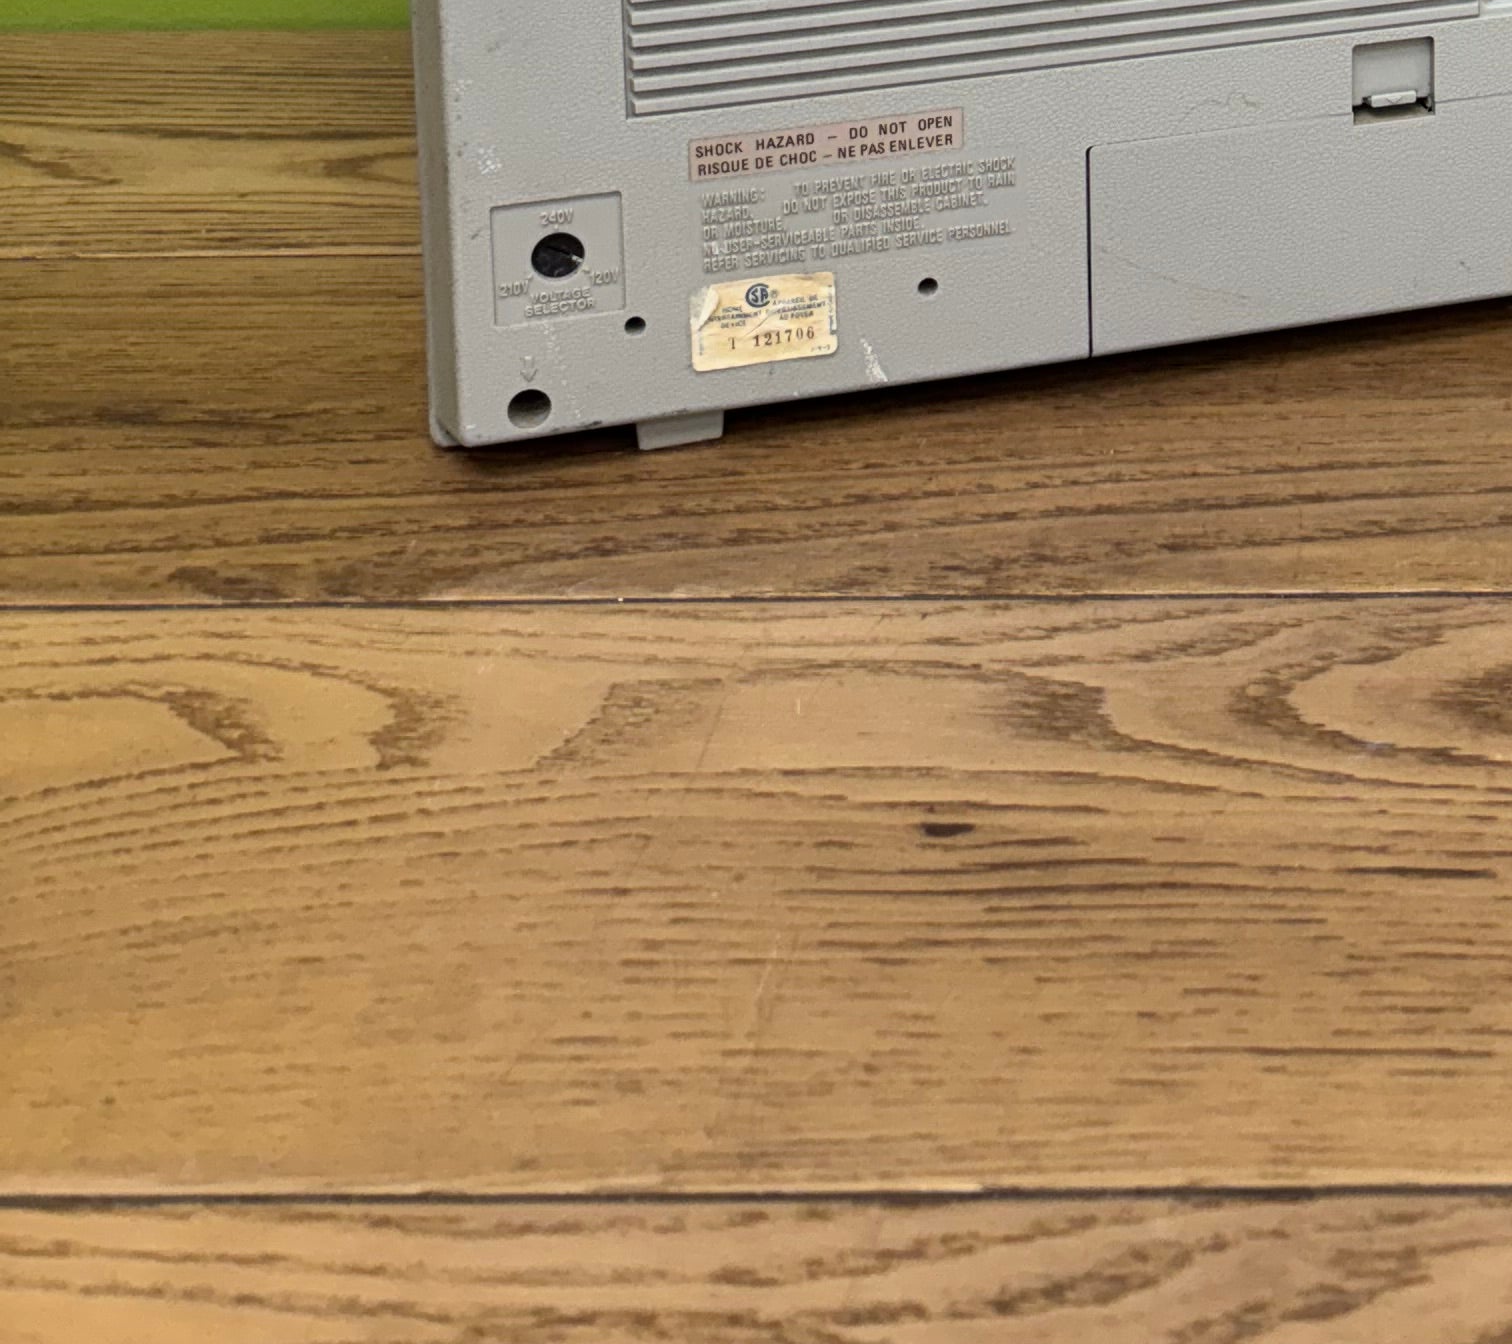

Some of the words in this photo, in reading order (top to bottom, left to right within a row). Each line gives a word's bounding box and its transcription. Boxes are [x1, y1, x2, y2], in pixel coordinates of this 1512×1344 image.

[695, 141, 743, 159] SHOCK
[755, 132, 815, 152] HAZARD
[849, 125, 869, 140] DO
[878, 121, 908, 137] NOT
[917, 115, 953, 131] OPEN
[698, 159, 750, 177] RISQUE
[755, 155, 774, 170] DE
[779, 149, 817, 167] CHOC
[837, 144, 856, 160] NE
[860, 139, 886, 156] PAS
[889, 133, 953, 153] ENLEVER
[702, 187, 767, 208] WARNING:
[794, 182, 809, 197] TO
[814, 175, 864, 194] PREVENT
[871, 170, 896, 186] FIRE
[902, 167, 915, 183] OR
[921, 160, 974, 180] ELECTRIC
[978, 156, 1015, 174] SHOCK
[783, 198, 799, 216] DO
[803, 195, 828, 213] NOT
[833, 189, 876, 209] EXPOSE
[880, 185, 907, 201] THIS
[912, 177, 963, 197] PRODUCT
[968, 175, 983, 191] TO
[988, 171, 1015, 189] RAIN
[540, 208, 574, 226] 240V
[703, 224, 717, 240] OR
[833, 209, 849, 225] OR
[854, 197, 930, 221] DISASSEMBLE
[841, 221, 878, 239] PARTS
[703, 255, 739, 273] REFER
[743, 247, 808, 269] SERVICING
[811, 243, 827, 260] TO
[831, 236, 890, 258] QUALIFIED
[895, 228, 944, 249] SERVICE
[499, 280, 529, 298] 210V
[591, 267, 619, 286] 120V
[530, 287, 591, 304] VOLTAGE
[525, 297, 595, 318] SELECTOR
[752, 325, 816, 348] 121706
